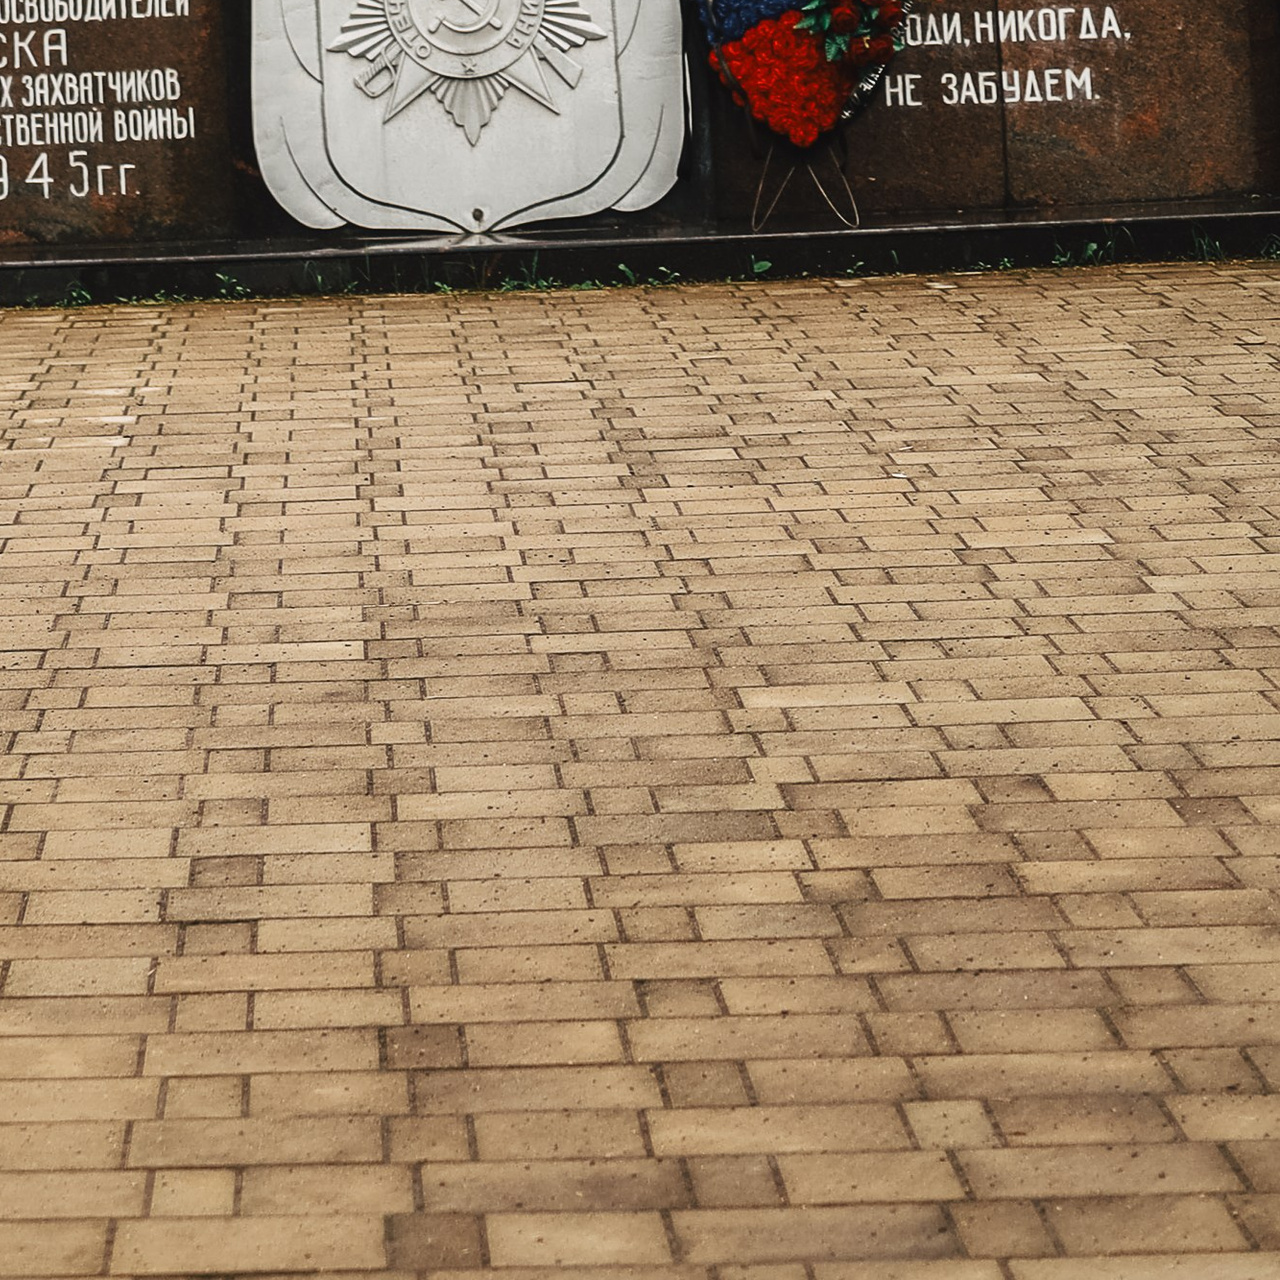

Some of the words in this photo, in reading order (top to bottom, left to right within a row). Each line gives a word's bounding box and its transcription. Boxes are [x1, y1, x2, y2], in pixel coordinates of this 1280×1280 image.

[973, 6, 1132, 44] НИКОГДА,
[20, 67, 181, 108] ЗАХВАТЧИКОВ
[884, 73, 923, 107] НЕ
[940, 66, 1101, 104] ЗАБУДЕМ.
[113, 104, 196, 143] ВОЙНЫ
